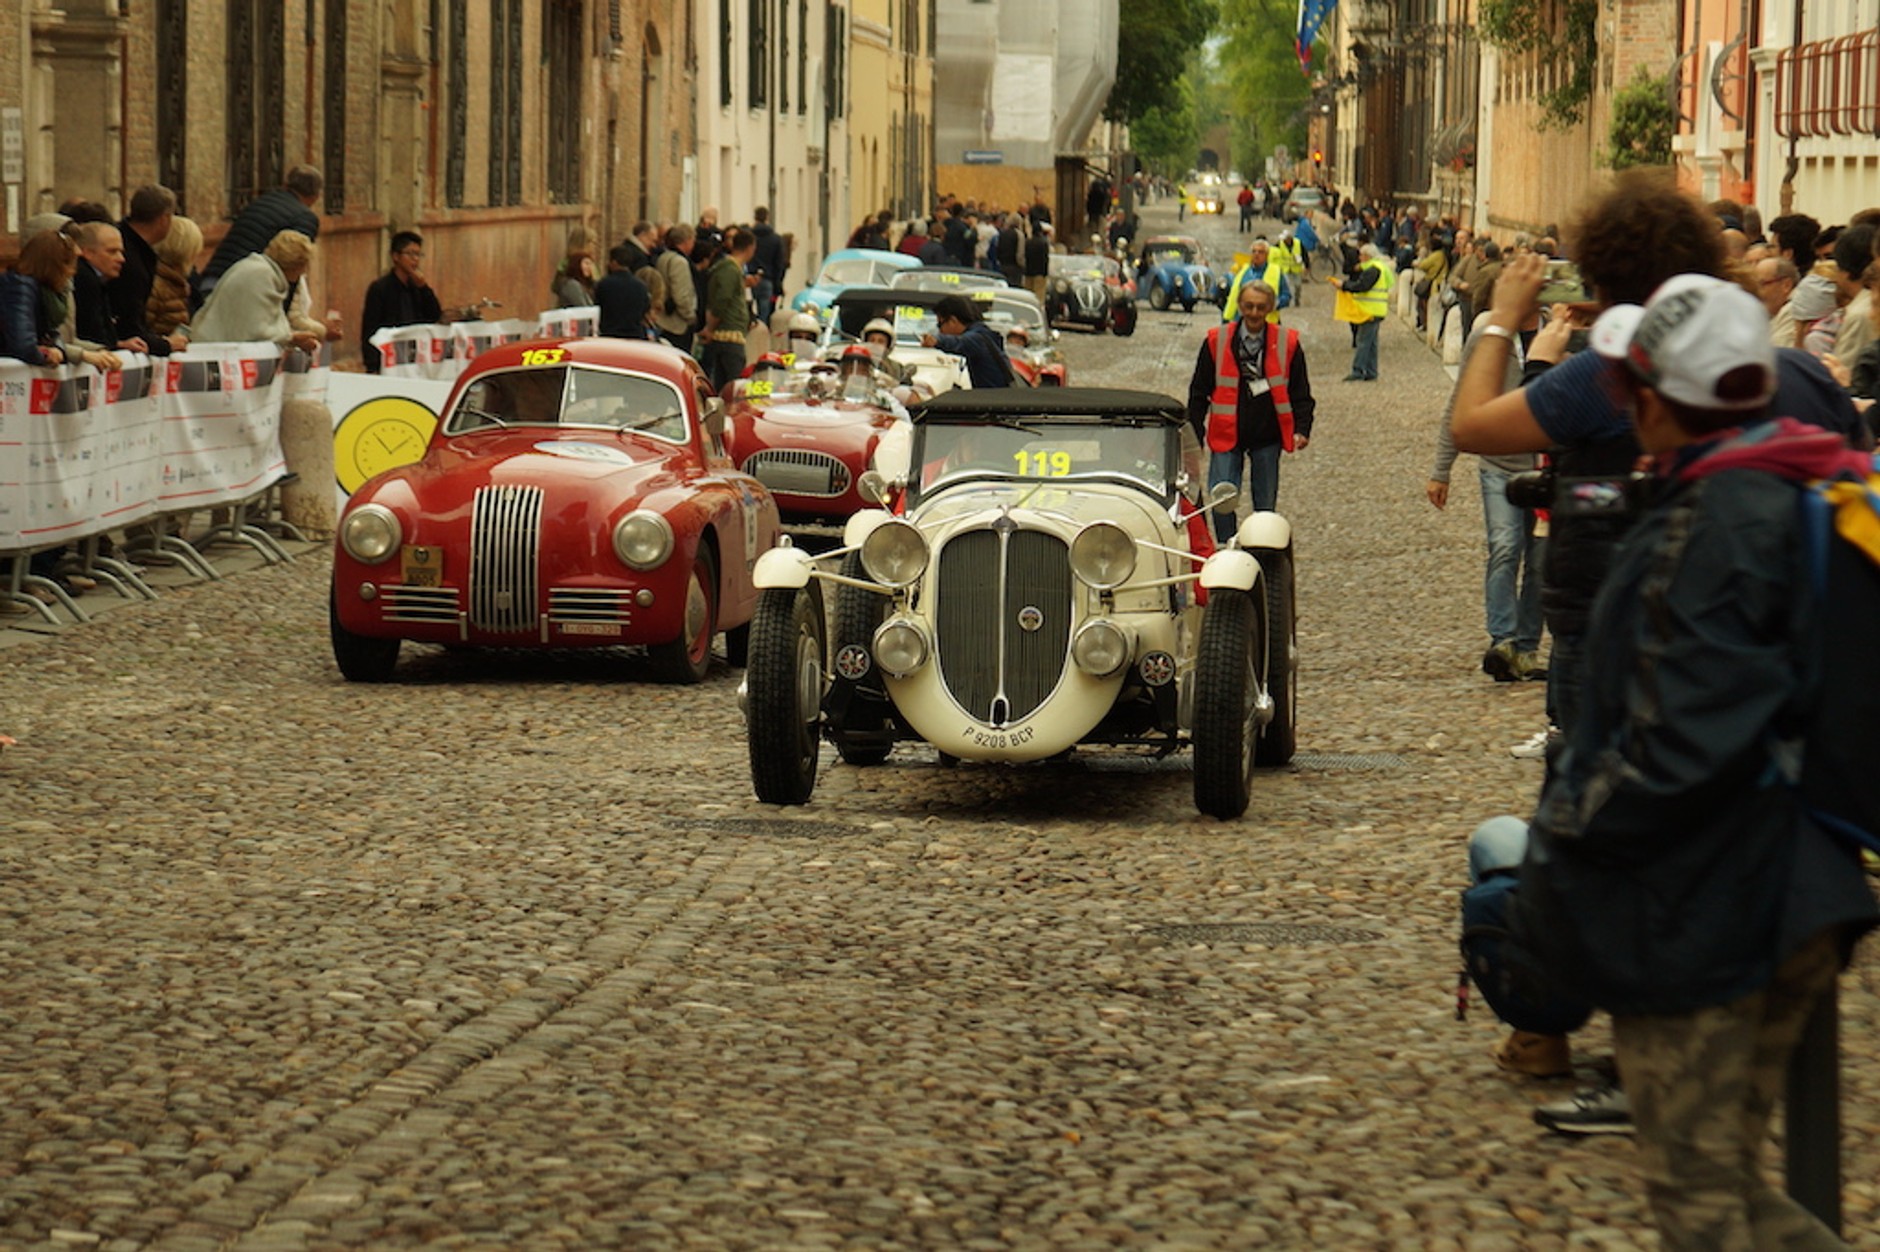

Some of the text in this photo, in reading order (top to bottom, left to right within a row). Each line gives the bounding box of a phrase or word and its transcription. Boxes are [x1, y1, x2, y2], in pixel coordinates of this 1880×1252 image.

[521, 349, 564, 366] 163
[5, 381, 25, 396] 2016
[745, 381, 774, 396] 165
[1013, 450, 1071, 476] 119
[962, 726, 1034, 749] P 9208 BCP
